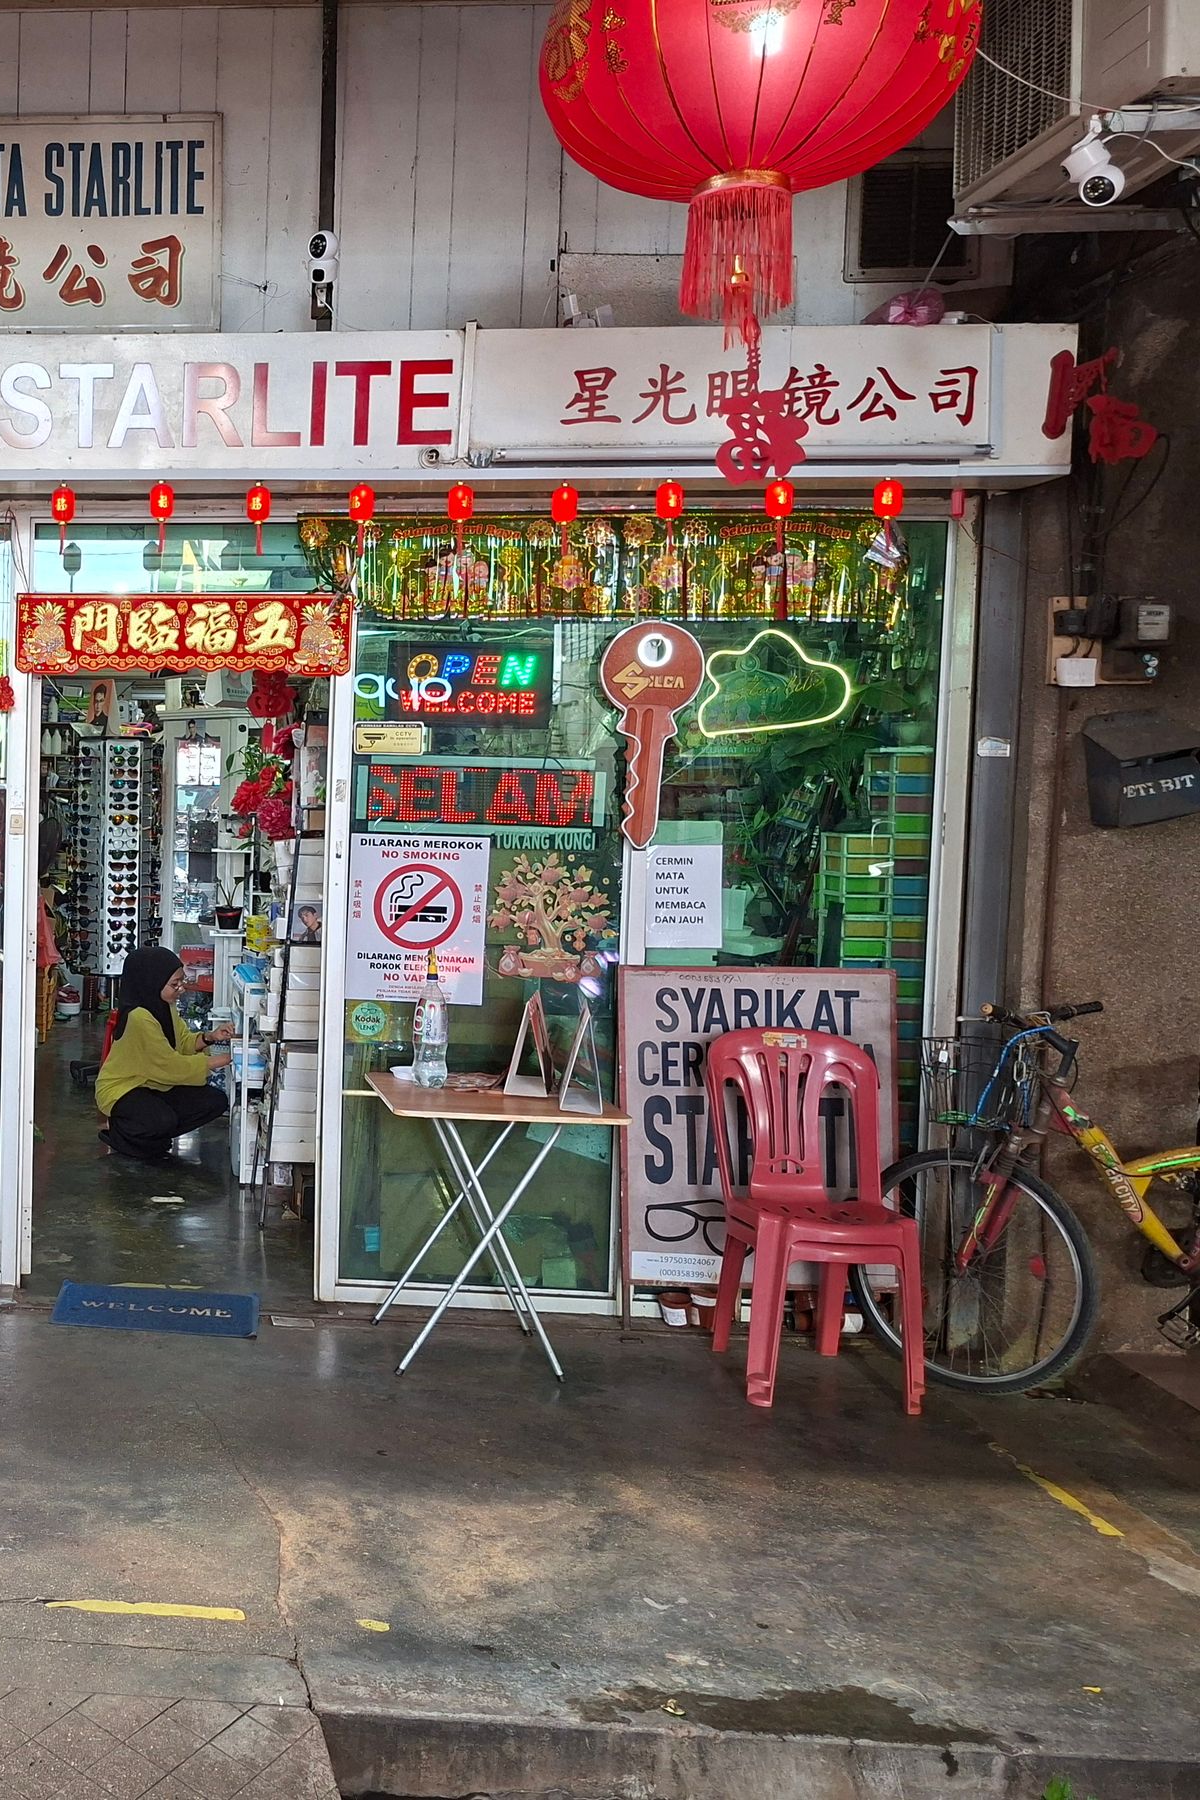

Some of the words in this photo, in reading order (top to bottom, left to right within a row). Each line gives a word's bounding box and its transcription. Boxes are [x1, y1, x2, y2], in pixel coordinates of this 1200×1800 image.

[44, 140, 205, 217] STARLITE
[407, 652, 537, 685] OPEN
[361, 838, 420, 848] DILARANG
[424, 840, 483, 850] MEROKOK
[495, 832, 549, 849] TUKANG
[554, 833, 595, 850] KUNCI
[382, 851, 398, 859] NO
[403, 851, 460, 861] SMOKING
[656, 857, 693, 866] CERMIN
[655, 872, 685, 880] MATA
[655, 886, 689, 895] UNTUK
[655, 901, 706, 909] MEMBACA
[655, 916, 676, 924] DAN
[679, 916, 704, 924] JAUH
[357, 952, 402, 960] DILARANG
[369, 963, 401, 971] ROKOK
[384, 973, 400, 981] NO
[655, 987, 860, 1036] SYARIKAT
[355, 1014, 381, 1024] Kodak
[659, 1256, 716, 1266] 197503024067
[82, 1300, 232, 1318] WELCOME
